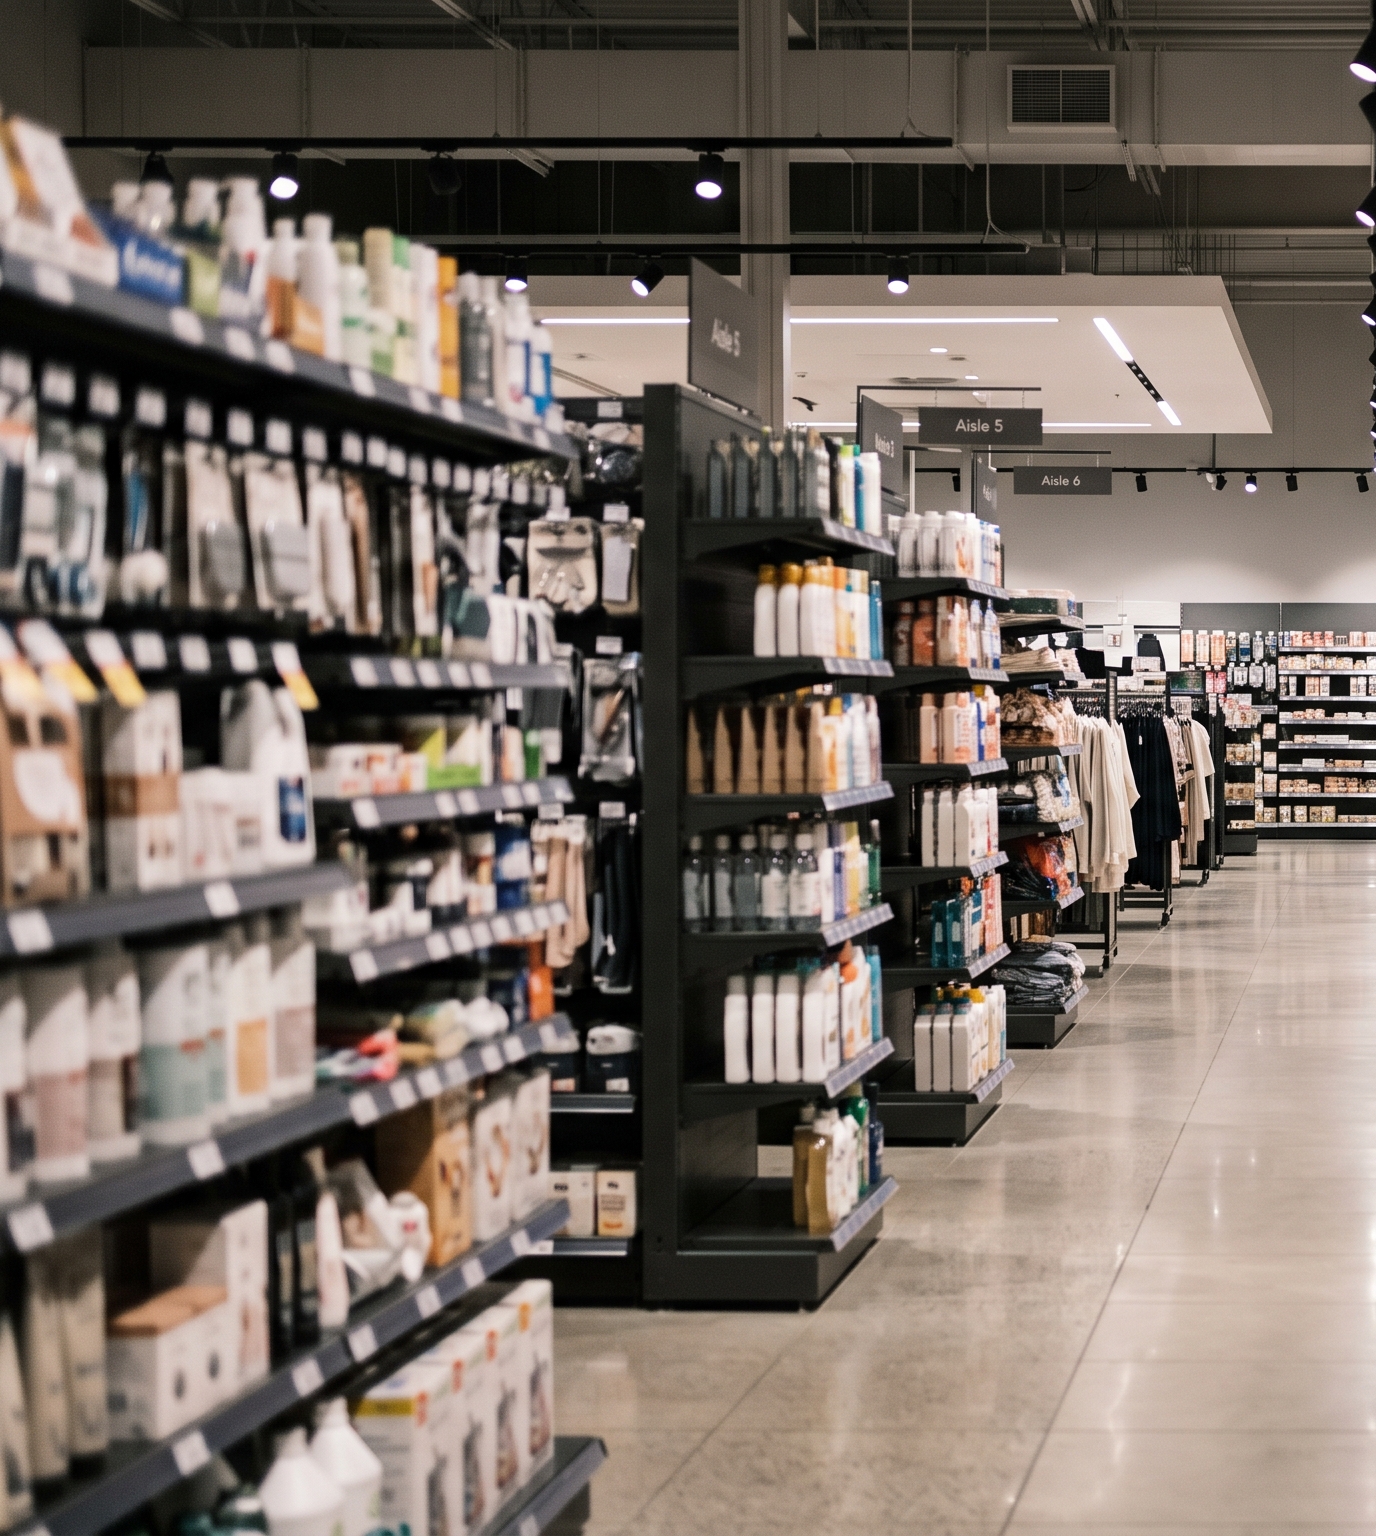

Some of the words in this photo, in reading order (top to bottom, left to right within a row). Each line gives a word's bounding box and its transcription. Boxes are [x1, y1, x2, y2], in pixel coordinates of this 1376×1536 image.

[955, 418, 990, 433] Aisle
[994, 419, 1004, 433] 5
[1041, 475, 1070, 487] Aisle
[1072, 475, 1081, 487] 6
